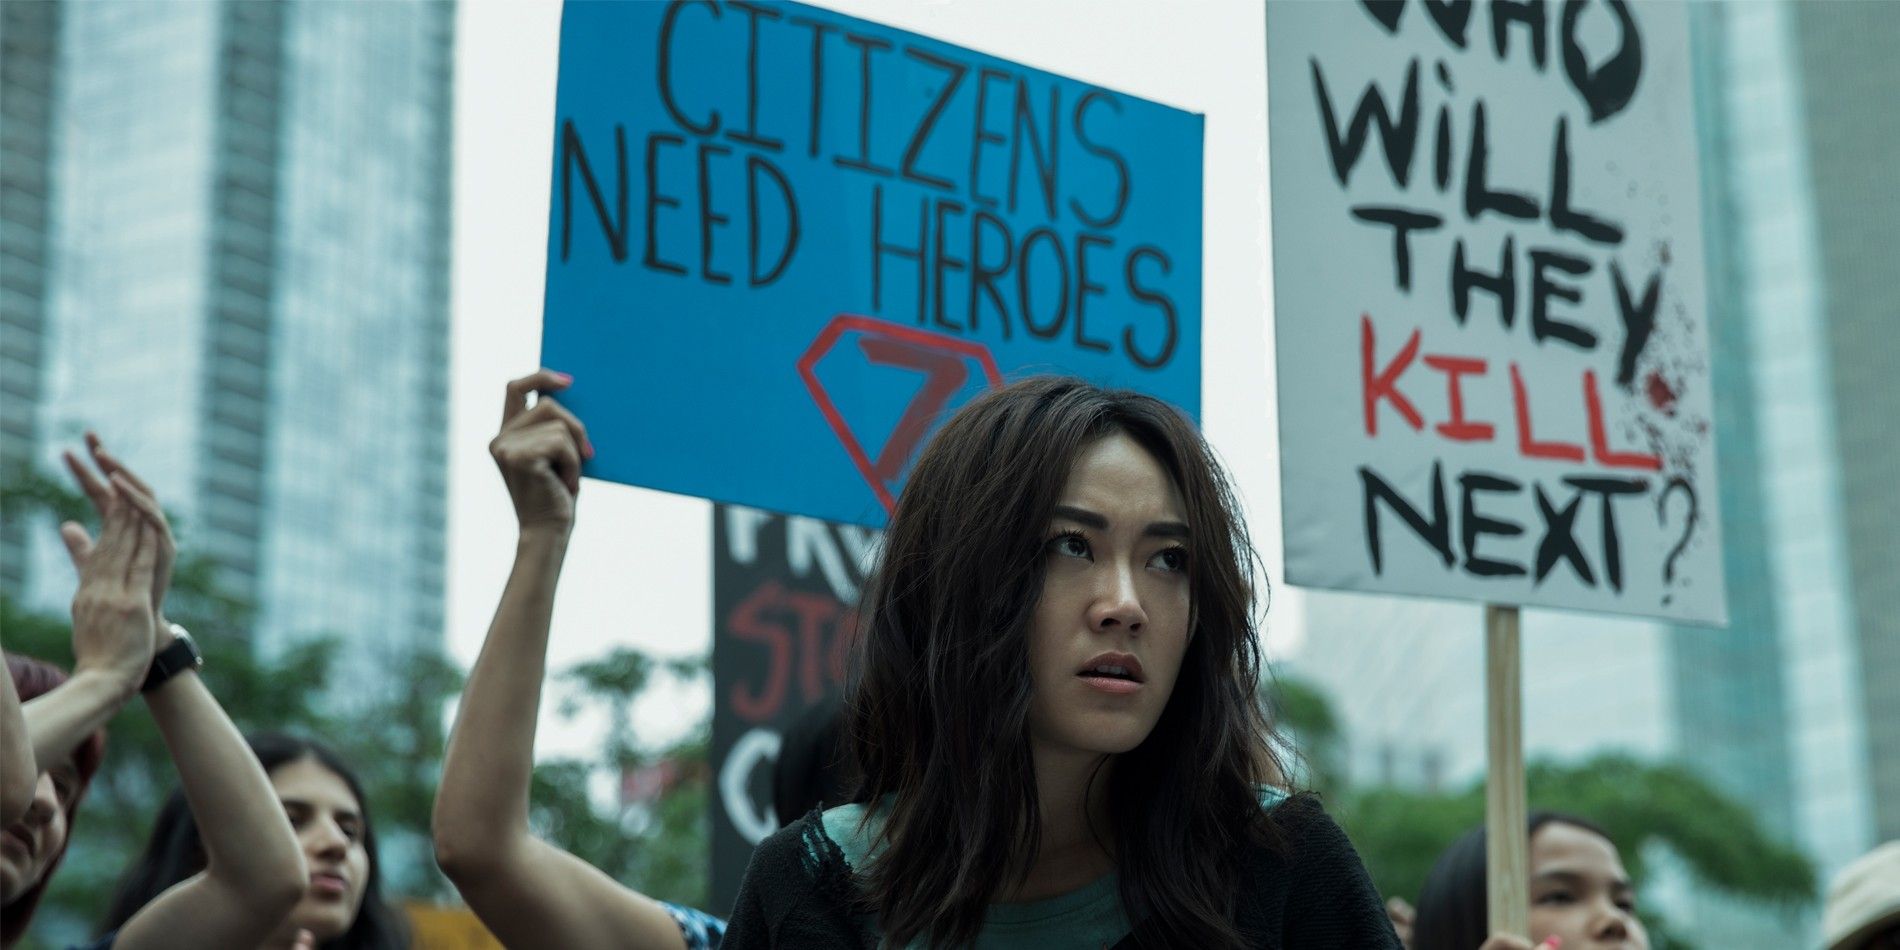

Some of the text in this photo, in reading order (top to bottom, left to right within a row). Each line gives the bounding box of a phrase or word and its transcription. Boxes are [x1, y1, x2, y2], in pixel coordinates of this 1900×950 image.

[657, 0, 1132, 229] CITIZENS
[560, 117, 1178, 371] NEED HEROES
[1350, 205, 1662, 386] THEY
[1362, 313, 1663, 471] KILL
[1357, 458, 1698, 607] NEXT?
